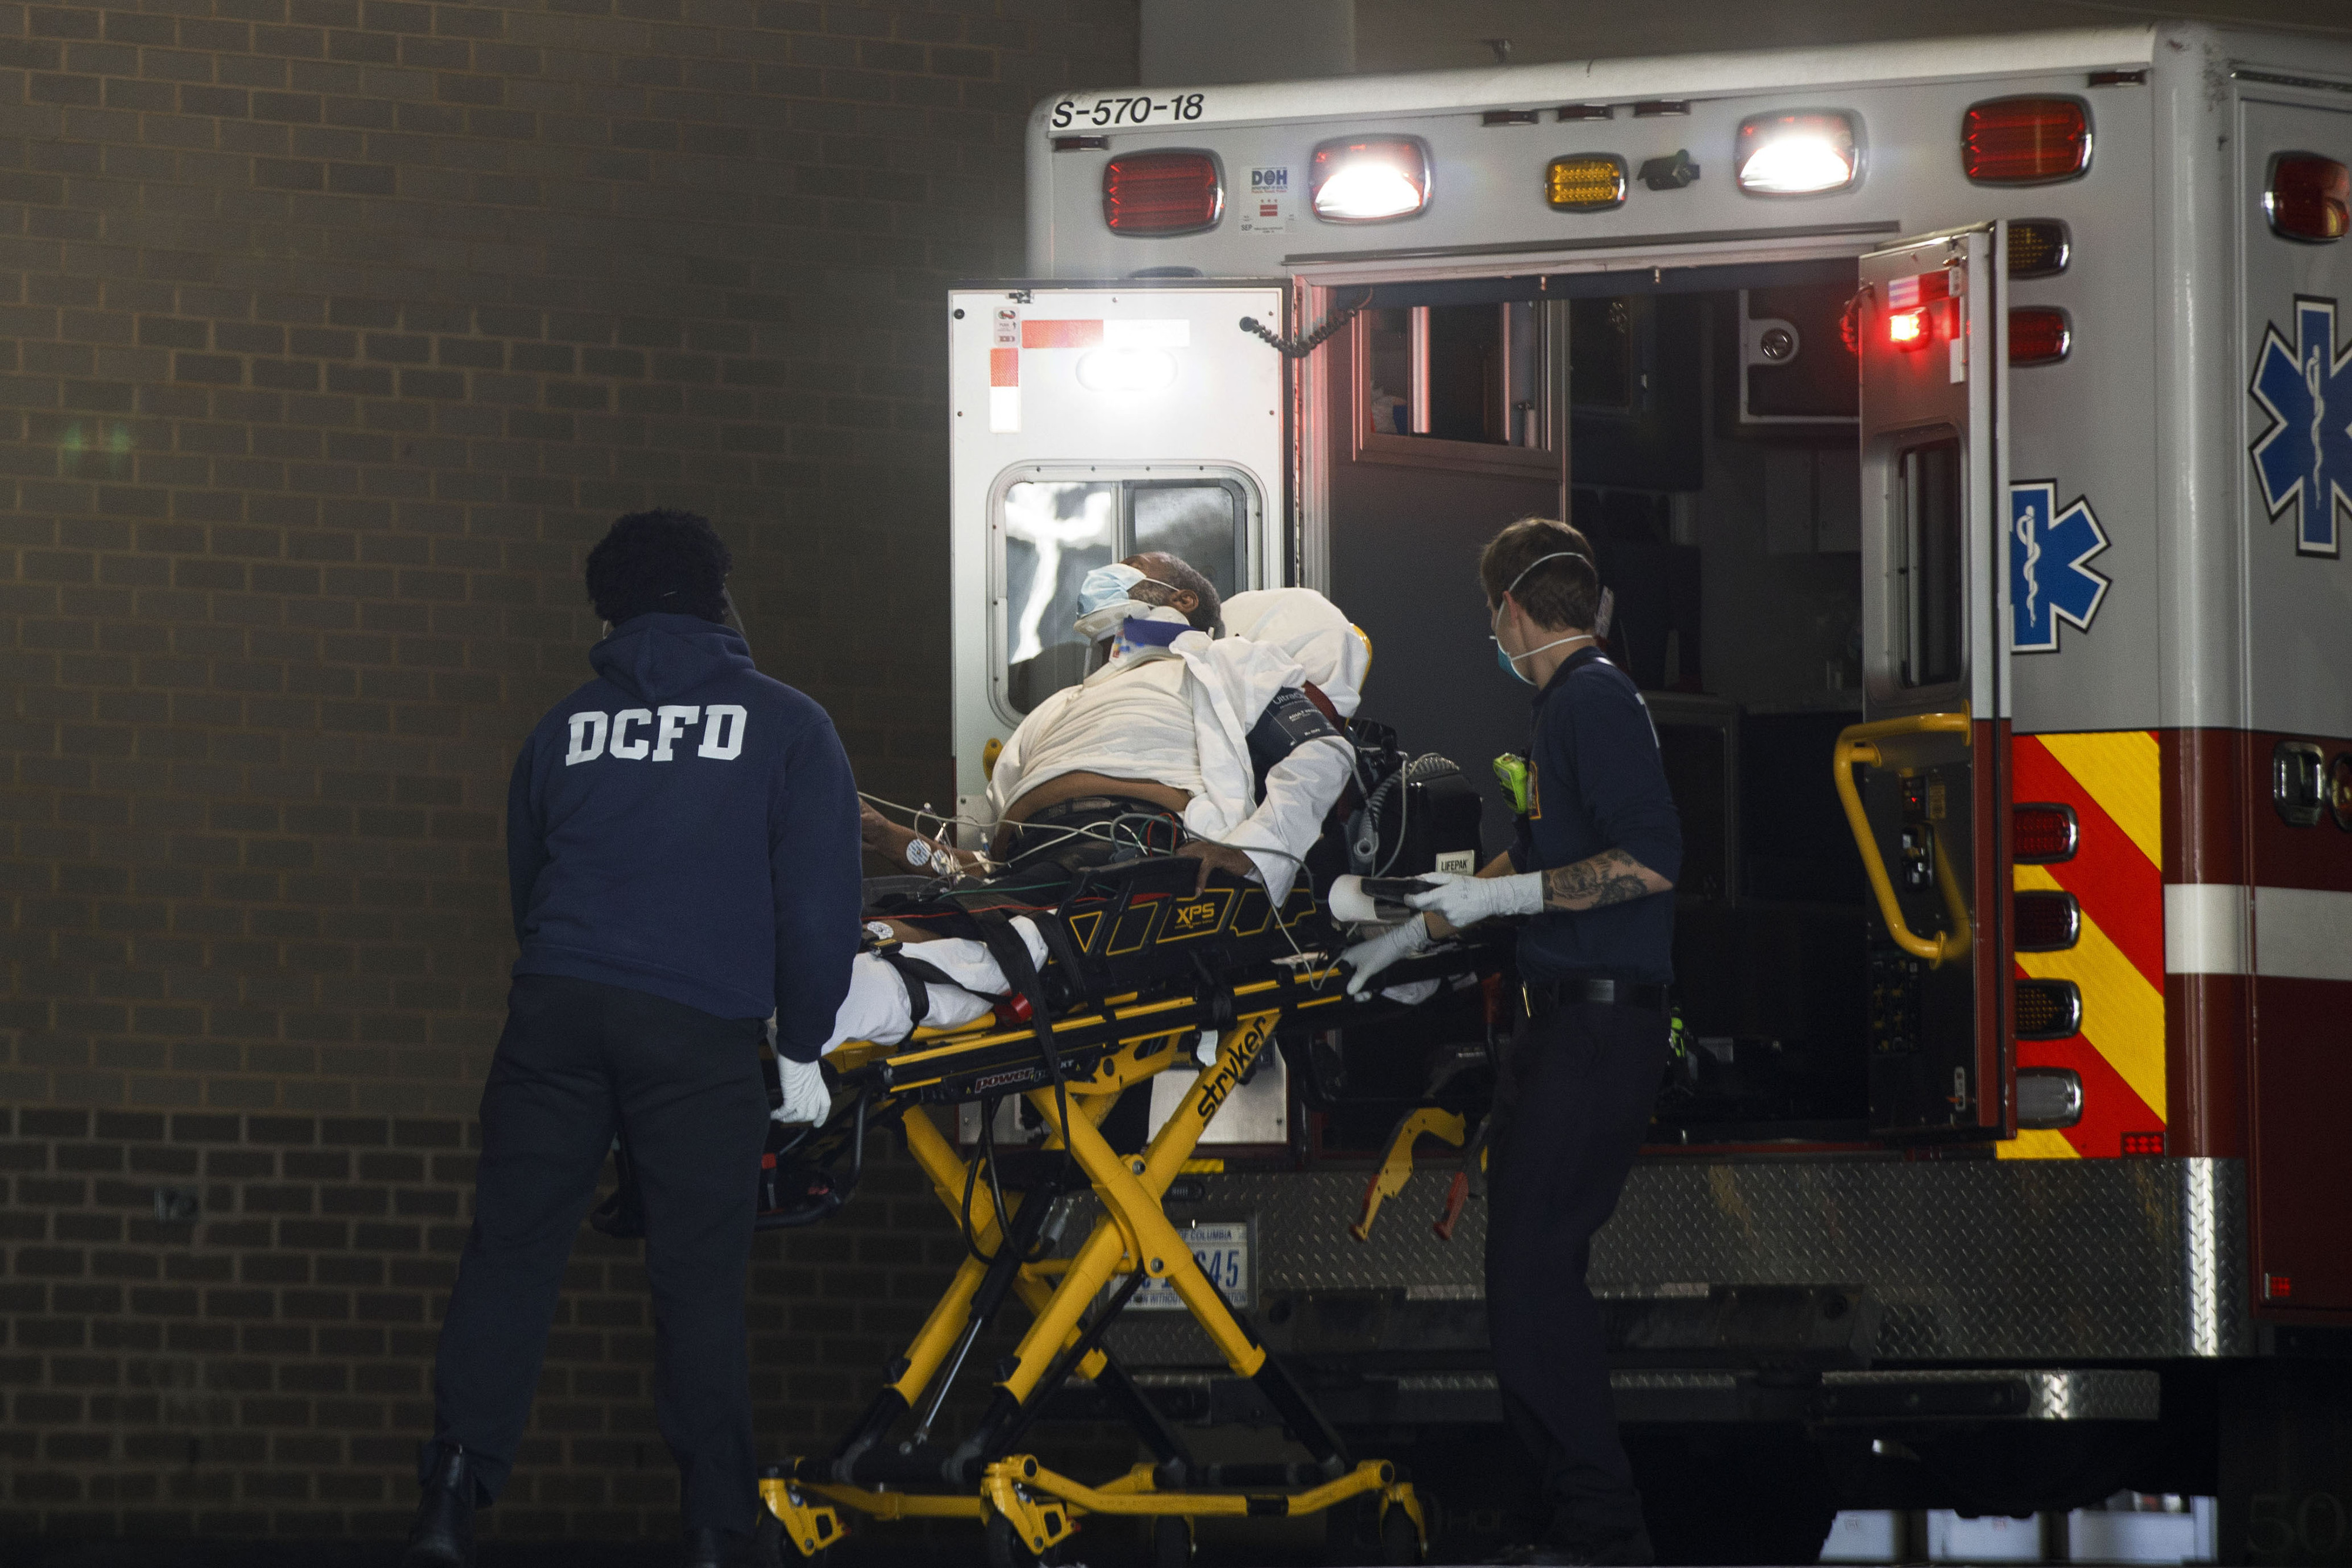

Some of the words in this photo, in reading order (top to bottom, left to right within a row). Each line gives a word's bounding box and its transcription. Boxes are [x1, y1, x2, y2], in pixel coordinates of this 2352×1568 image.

[1052, 93, 1204, 128] S-570-18
[1251, 169, 1287, 186] DOH
[566, 704, 748, 767] DCFD
[1441, 858, 1467, 871] LIFEPAK
[1176, 901, 1215, 928] XPS
[975, 1066, 1035, 1094] power
[1197, 1016, 1266, 1126] stryker
[1191, 1229, 1231, 1241] COLUMBIA
